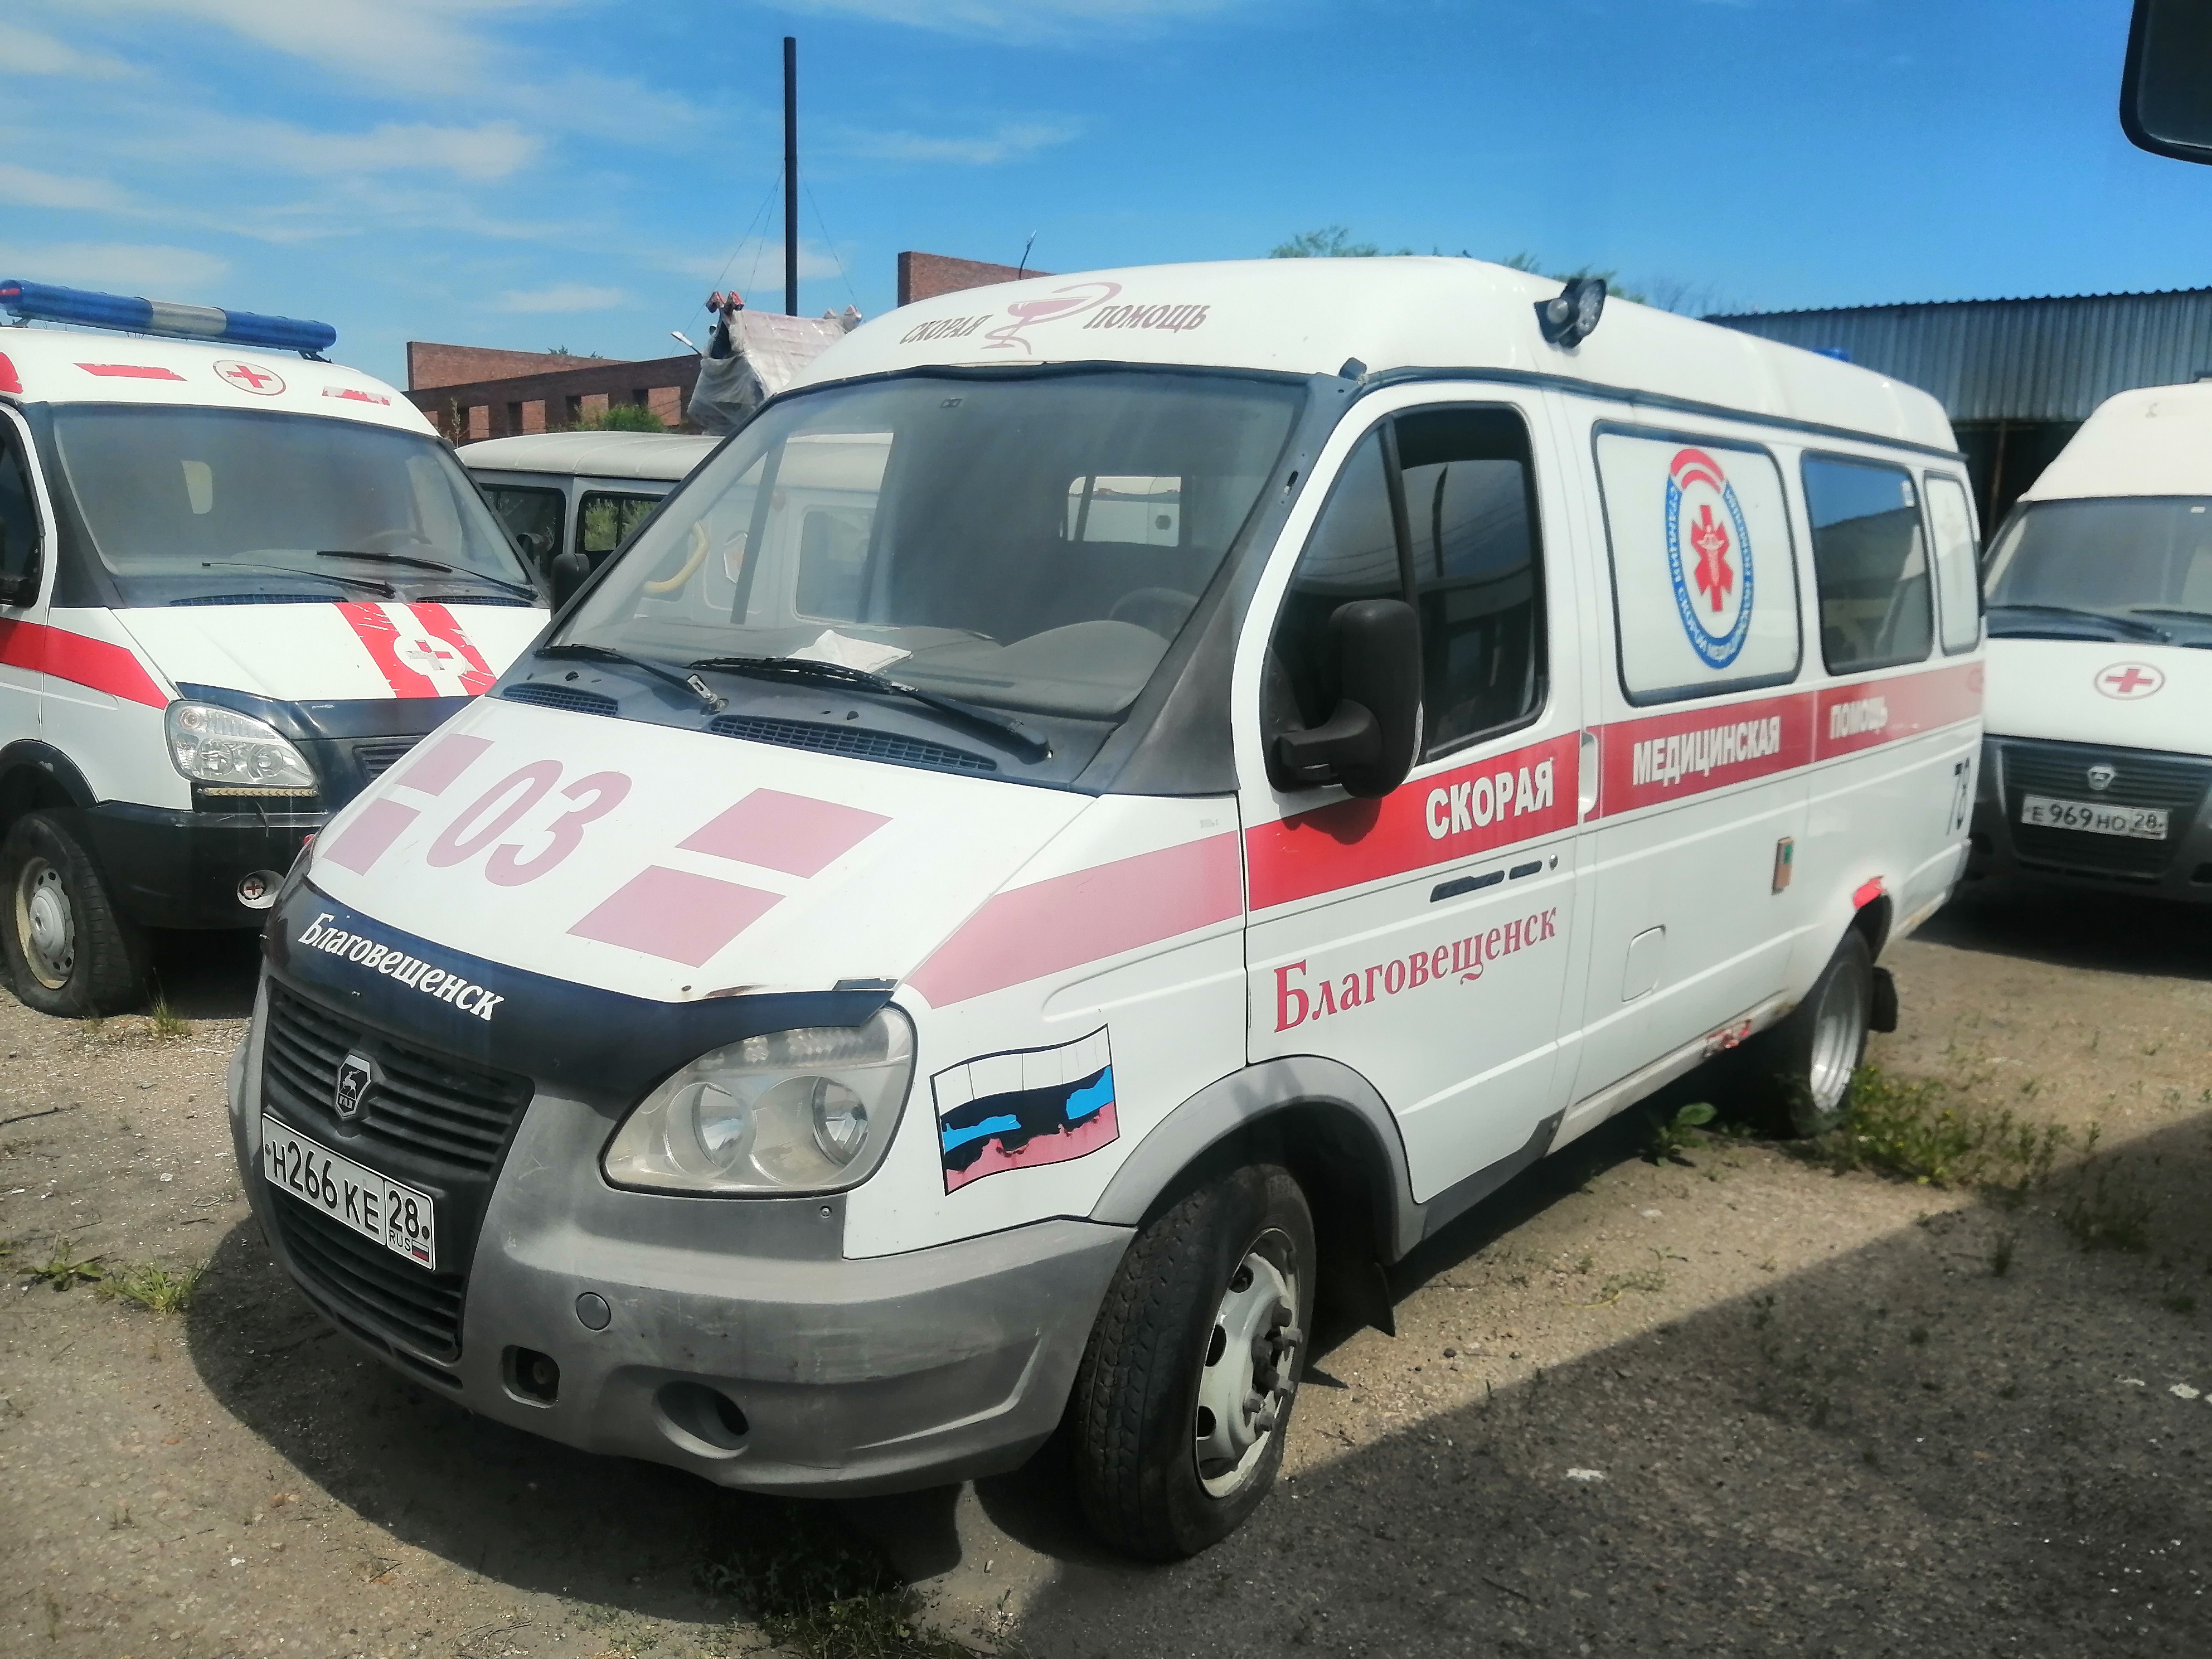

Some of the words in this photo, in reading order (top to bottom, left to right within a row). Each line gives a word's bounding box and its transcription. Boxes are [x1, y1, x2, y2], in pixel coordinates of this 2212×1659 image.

[900, 314, 993, 345] СКОРАЯ
[1083, 304, 1211, 334] ПОМОЩЬ
[426, 759, 633, 887] 03
[1426, 758, 1554, 840] СКОРАЯ
[1633, 716, 1781, 787] МЕДИЦИНСКАЯ
[298, 913, 505, 1021] Благовещенск
[1274, 907, 1556, 1033] Благовещенск
[389, 1189, 420, 1239] 28
[389, 1229, 411, 1252] RUS
